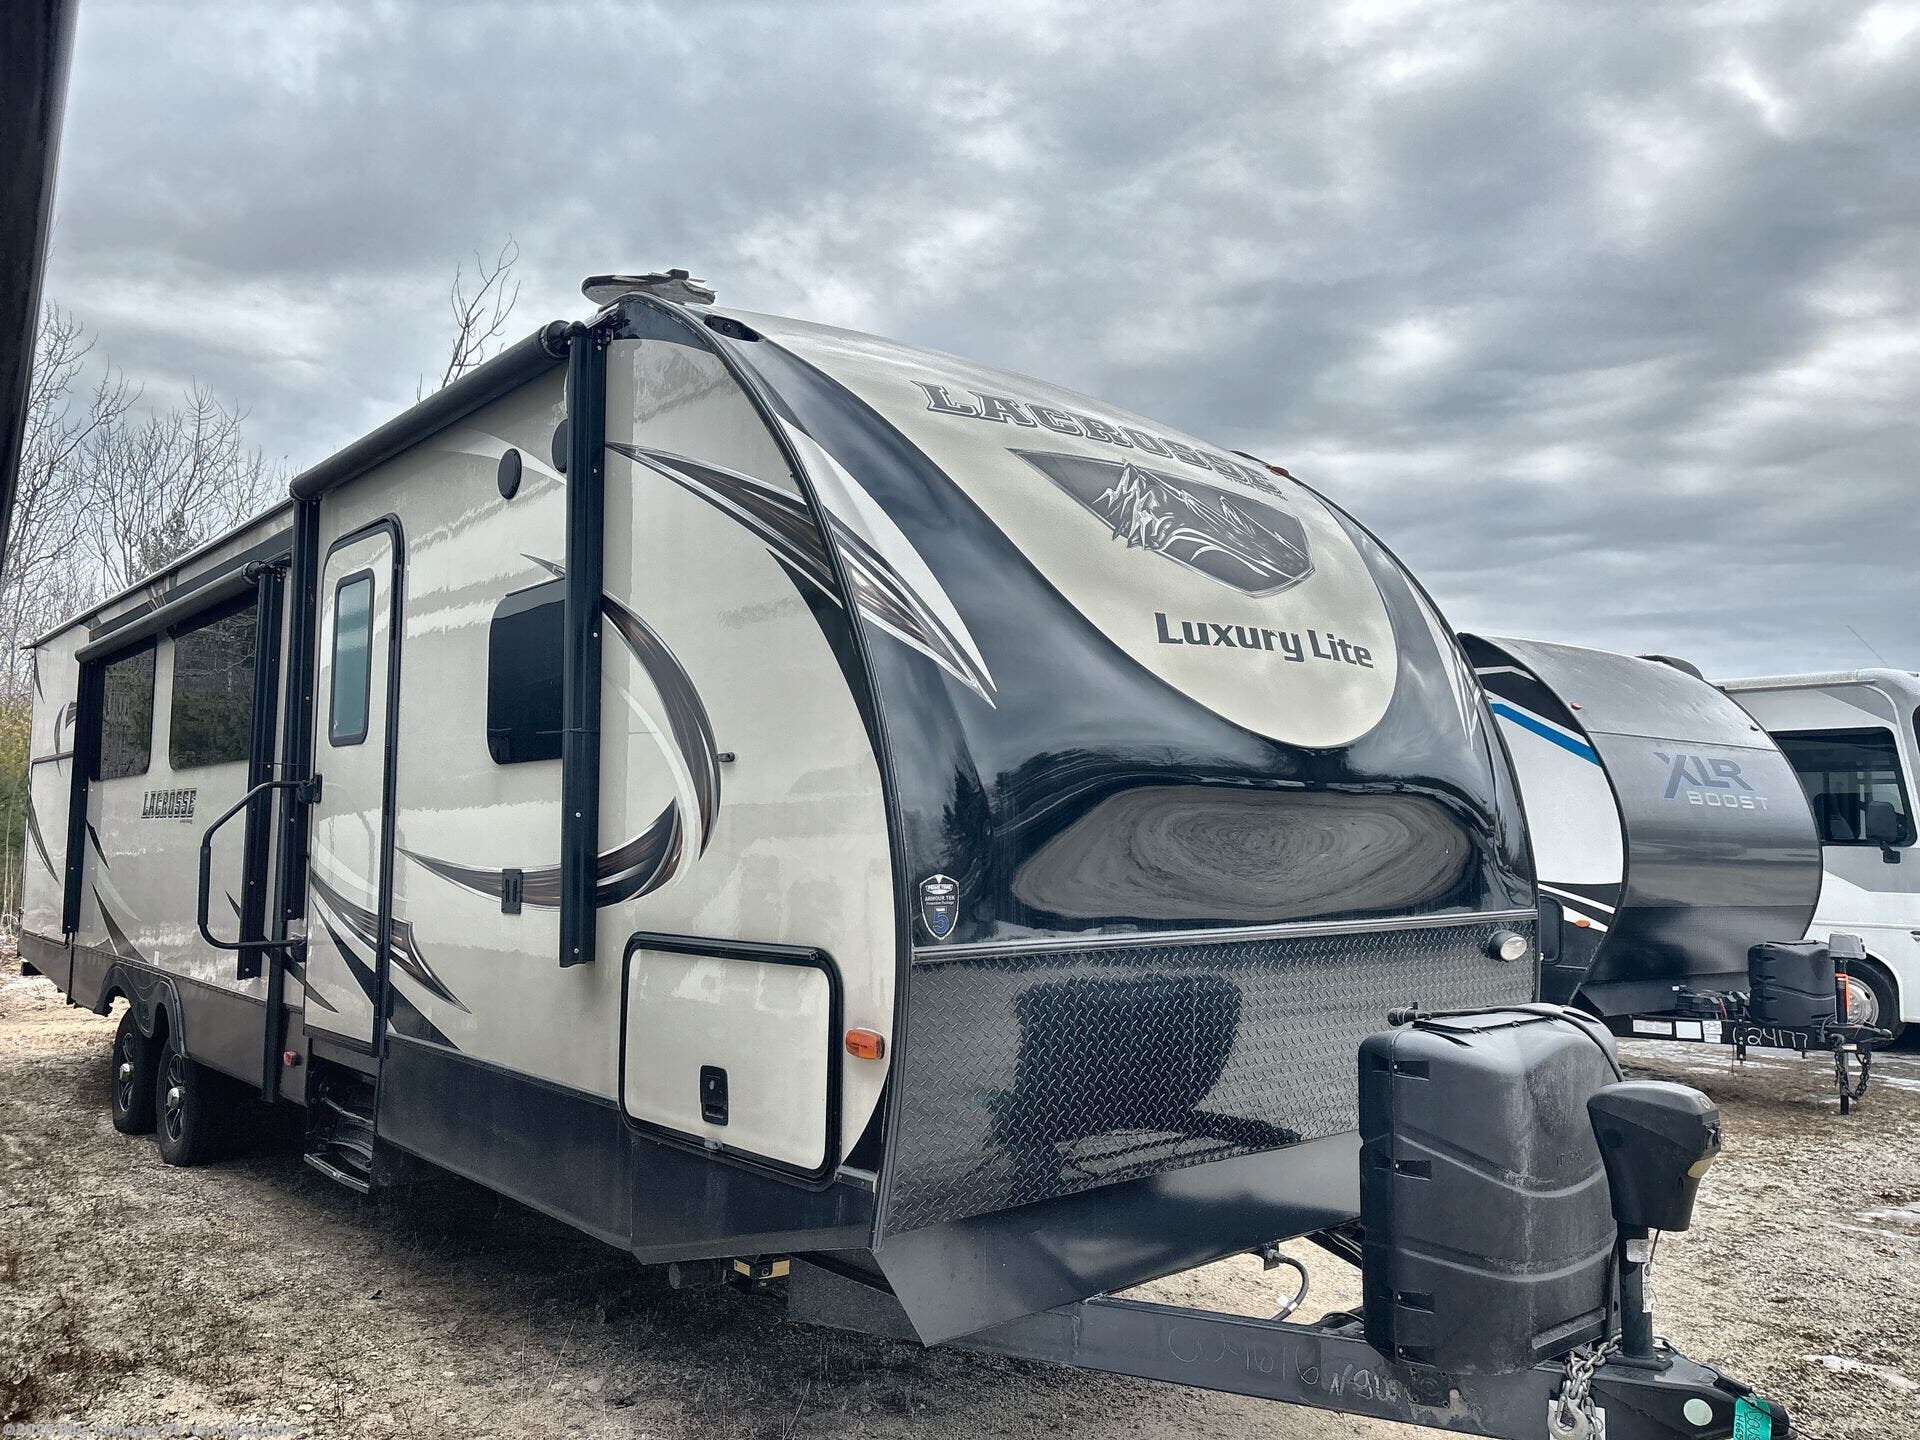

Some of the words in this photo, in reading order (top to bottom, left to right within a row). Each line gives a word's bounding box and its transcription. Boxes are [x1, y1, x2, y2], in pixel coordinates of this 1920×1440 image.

[910, 379, 1283, 496] LACROSSE
[1154, 612, 1305, 662] Luxury
[1307, 628, 1374, 668] Lite
[1652, 751, 1755, 801] XLR
[141, 787, 197, 819] LACROSSE
[1686, 790, 1769, 810] BOOST
[932, 906, 950, 934] 5
